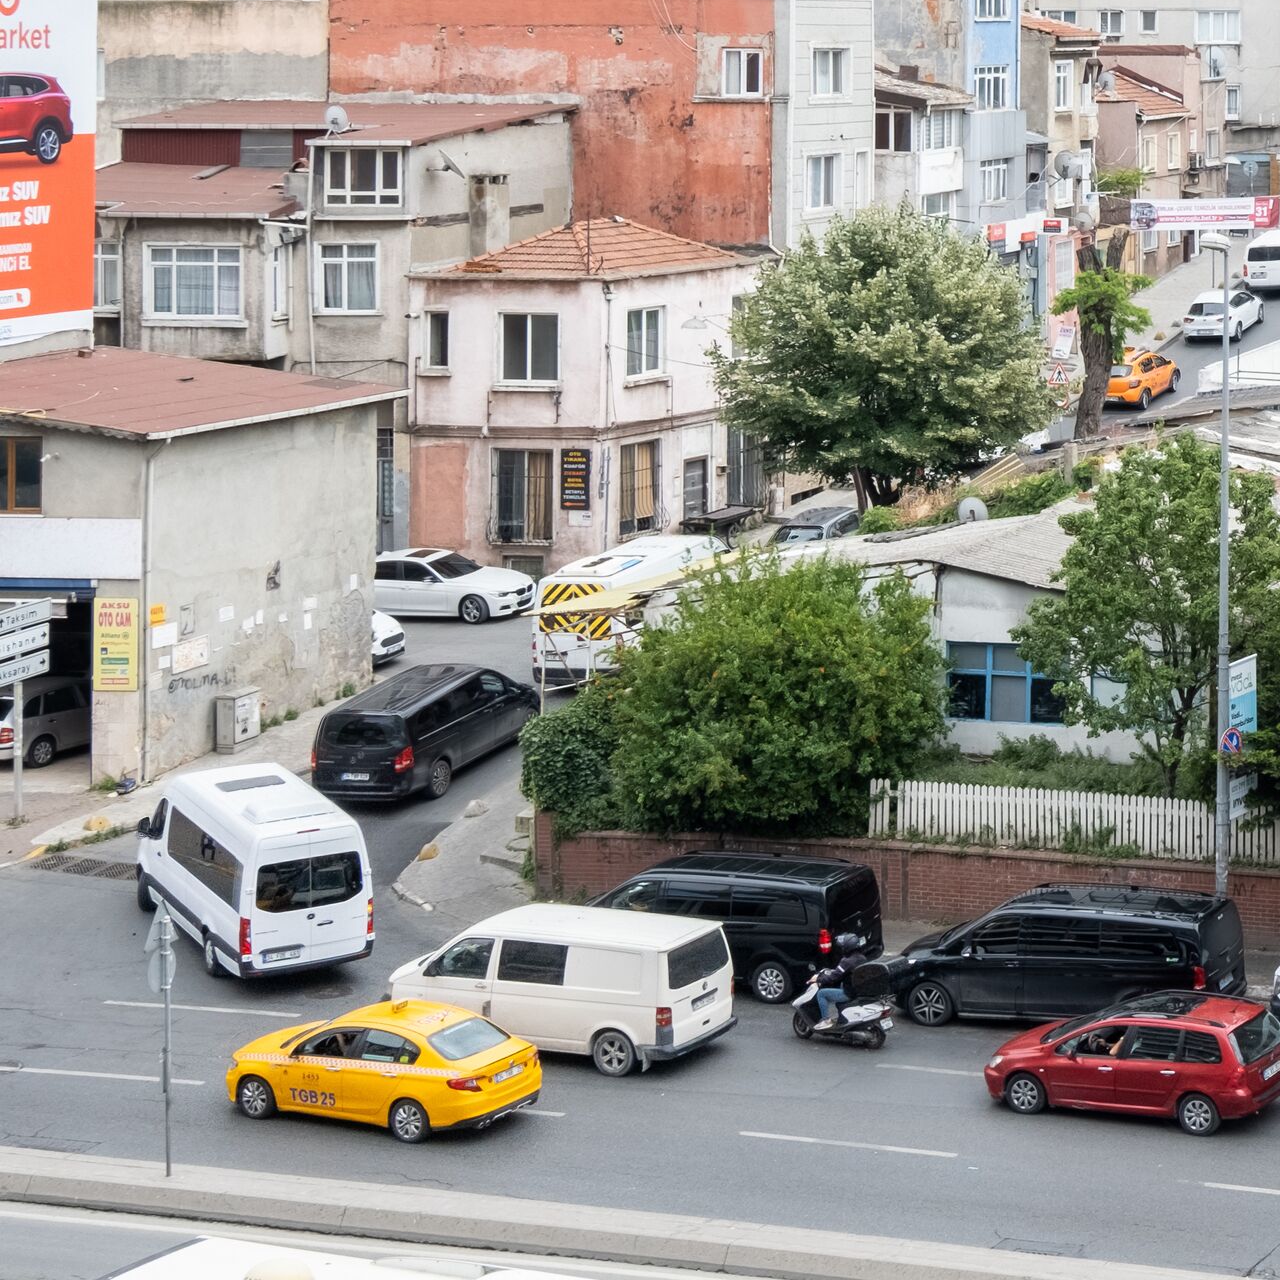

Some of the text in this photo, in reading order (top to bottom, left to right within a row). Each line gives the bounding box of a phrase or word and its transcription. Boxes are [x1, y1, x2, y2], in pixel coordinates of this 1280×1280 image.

[12, 180, 40, 201] SUV
[23, 205, 51, 226] SUV
[1255, 206, 1268, 217] 31
[5, 610, 38, 626] Taksim
[98, 611, 114, 627] OTO
[115, 611, 132, 627] CAM
[289, 1087, 337, 1107] TGB 25
